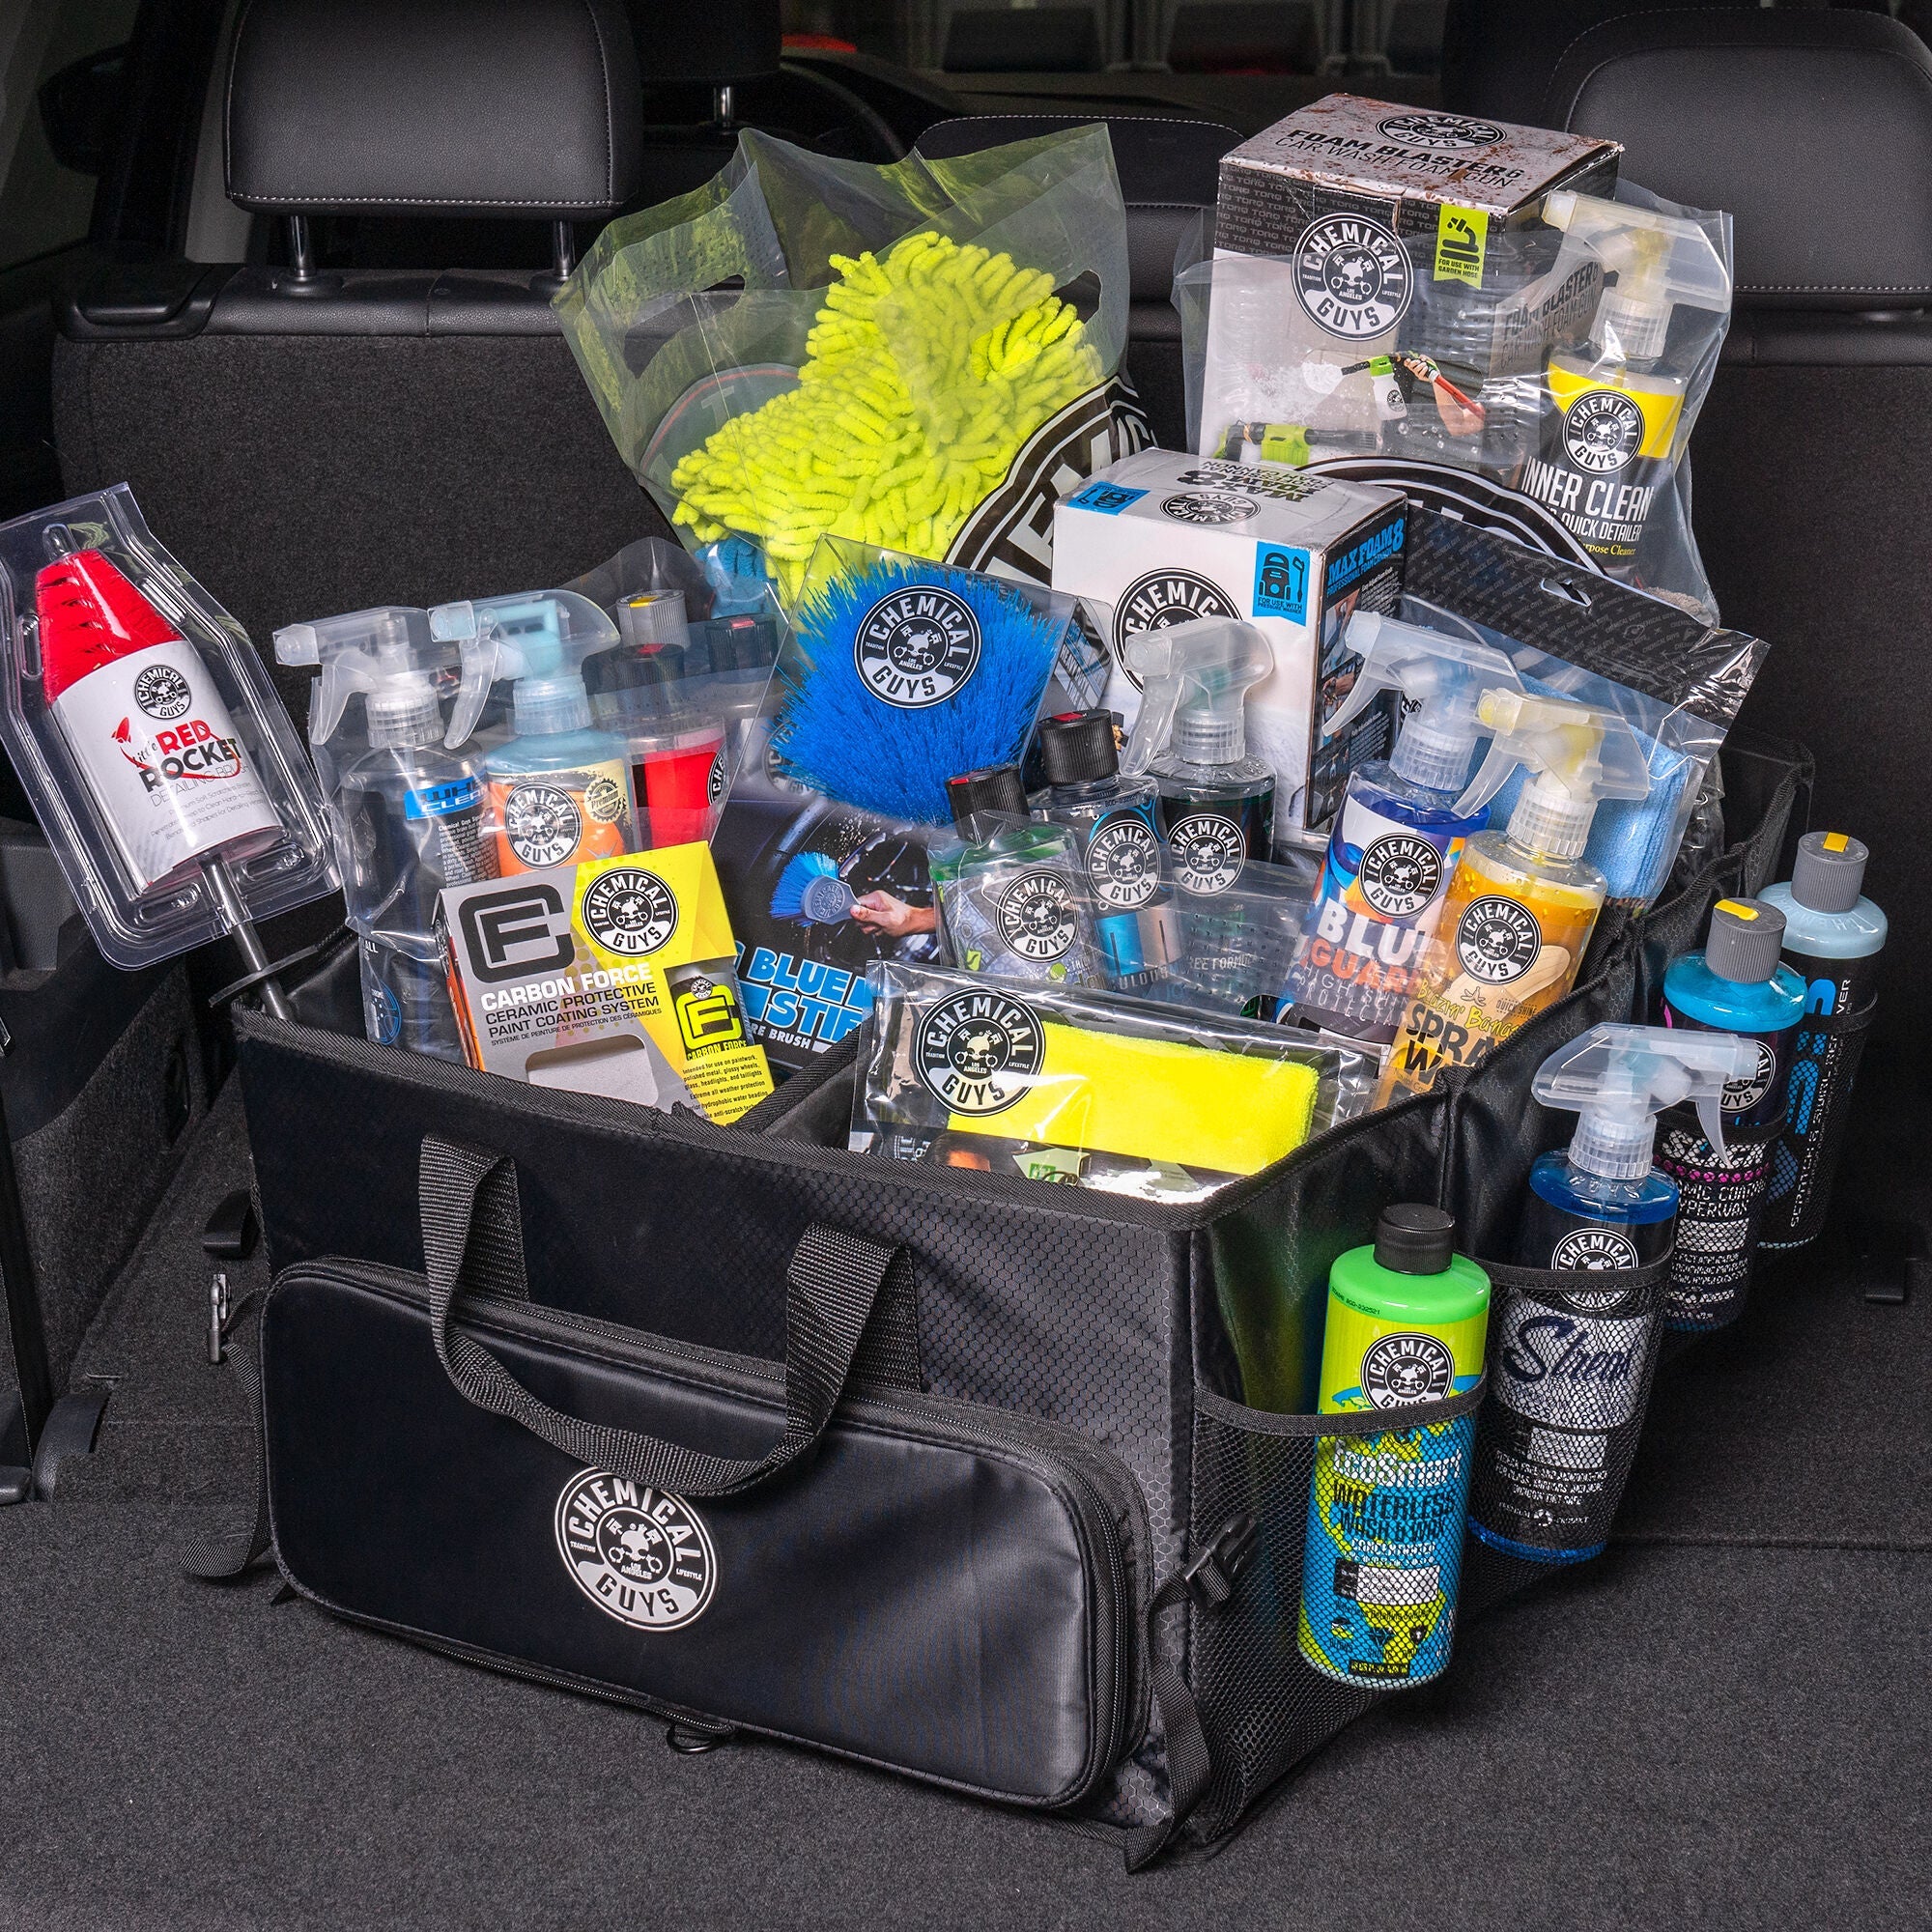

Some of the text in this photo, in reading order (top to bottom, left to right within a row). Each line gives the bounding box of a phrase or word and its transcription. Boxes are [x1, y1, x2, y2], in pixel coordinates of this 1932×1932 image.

[1287, 129, 1375, 151] FOAM
[1389, 115, 1496, 140] CHEMICAL
[1393, 130, 1458, 147] GUYS
[1275, 137, 1514, 187] CAR WASH FOAM GUN
[1303, 223, 1404, 284] CHEMICAL
[1463, 263, 1480, 271] WITH
[1438, 266, 1462, 275] GARDEN
[1317, 297, 1380, 330] GUYS
[1571, 397, 1637, 439] CHEMICAL
[1574, 444, 1618, 469] GUYS
[1199, 494, 1247, 505] GUYS
[1521, 456, 1582, 511] INNER
[1584, 480, 1655, 522] CLEAN
[1561, 513, 1598, 539] QUICK
[1599, 524, 1642, 542] DETAILER
[1610, 544, 1636, 555] Cleaner
[1327, 553, 1358, 586] MAX
[868, 595, 972, 658] CHEMICAL
[898, 661, 923, 670] ANGELES
[137, 668, 184, 700] CHEMICAL
[872, 665, 937, 698] GUYS
[160, 701, 185, 717] GUYS
[156, 720, 211, 755] RED
[138, 738, 242, 793] ROCKET
[509, 789, 574, 830] CHEMICAL
[591, 791, 618, 810] Premium
[522, 841, 565, 863] GUYS
[1092, 827, 1155, 872] CHEMICAL
[1171, 821, 1240, 857] CHEMICAL
[1368, 840, 1436, 883] CHEMICAL
[1110, 878, 1151, 902] GUYS
[1180, 872, 1226, 890] GUYS
[591, 874, 668, 919] CHEMICAL
[1005, 878, 1070, 925] CHEMICAL
[1371, 887, 1414, 911] GUYS
[613, 925, 662, 950] GUYS
[1466, 903, 1533, 951] CHEMICAL
[1026, 929, 1069, 954] GUYS
[747, 947, 853, 1005] BLUE
[1466, 951, 1509, 978] GUYS
[481, 962, 653, 1011] CARBON FORCE
[485, 982, 656, 1025] CERAMIC PROTECTIVE
[489, 996, 659, 1038] PAINT COATING SYSTEM
[1496, 999, 1516, 1013] QUICK
[521, 1032, 530, 1040] DE
[531, 1026, 561, 1037] PEINTURE
[572, 1017, 609, 1029] PROTECTION
[769, 1026, 810, 1050] BRUSH
[926, 997, 1034, 1056] CHEMICAL
[687, 1040, 747, 1061] CARBON FORCE
[683, 1065, 705, 1074] Intended
[684, 1072, 705, 1082] polished
[690, 1091, 711, 1099] Extreme
[720, 1086, 739, 1094] weather
[740, 1080, 765, 1091] protection
[701, 1097, 732, 1109] hydrophobic
[733, 1094, 747, 1103] water
[942, 1074, 1006, 1105] GUYS
[1720, 1090, 1752, 1106] UYS
[714, 1107, 743, 1118] anti-scratch
[1369, 1341, 1448, 1378] CHEMICAL
[569, 1478, 701, 1562] CHEMICAL
[596, 1573, 679, 1617] GUYS
